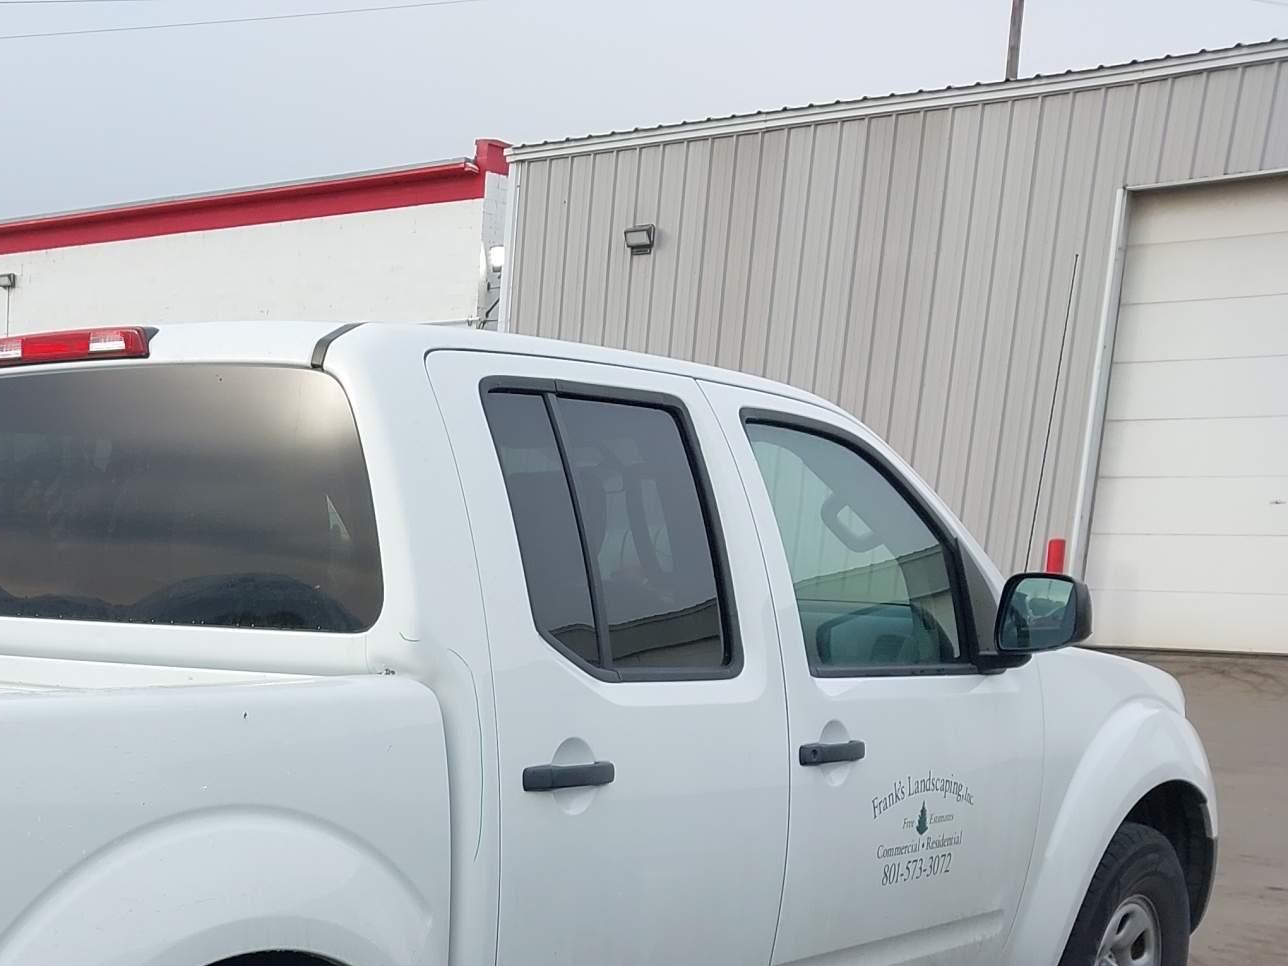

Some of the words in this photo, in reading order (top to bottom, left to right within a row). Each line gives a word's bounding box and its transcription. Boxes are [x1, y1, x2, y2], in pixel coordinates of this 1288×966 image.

[872, 780, 905, 819] Frank's
[876, 838, 920, 860] Commercial
[926, 830, 964, 851] Residential
[881, 852, 952, 886] 801-573-3072
